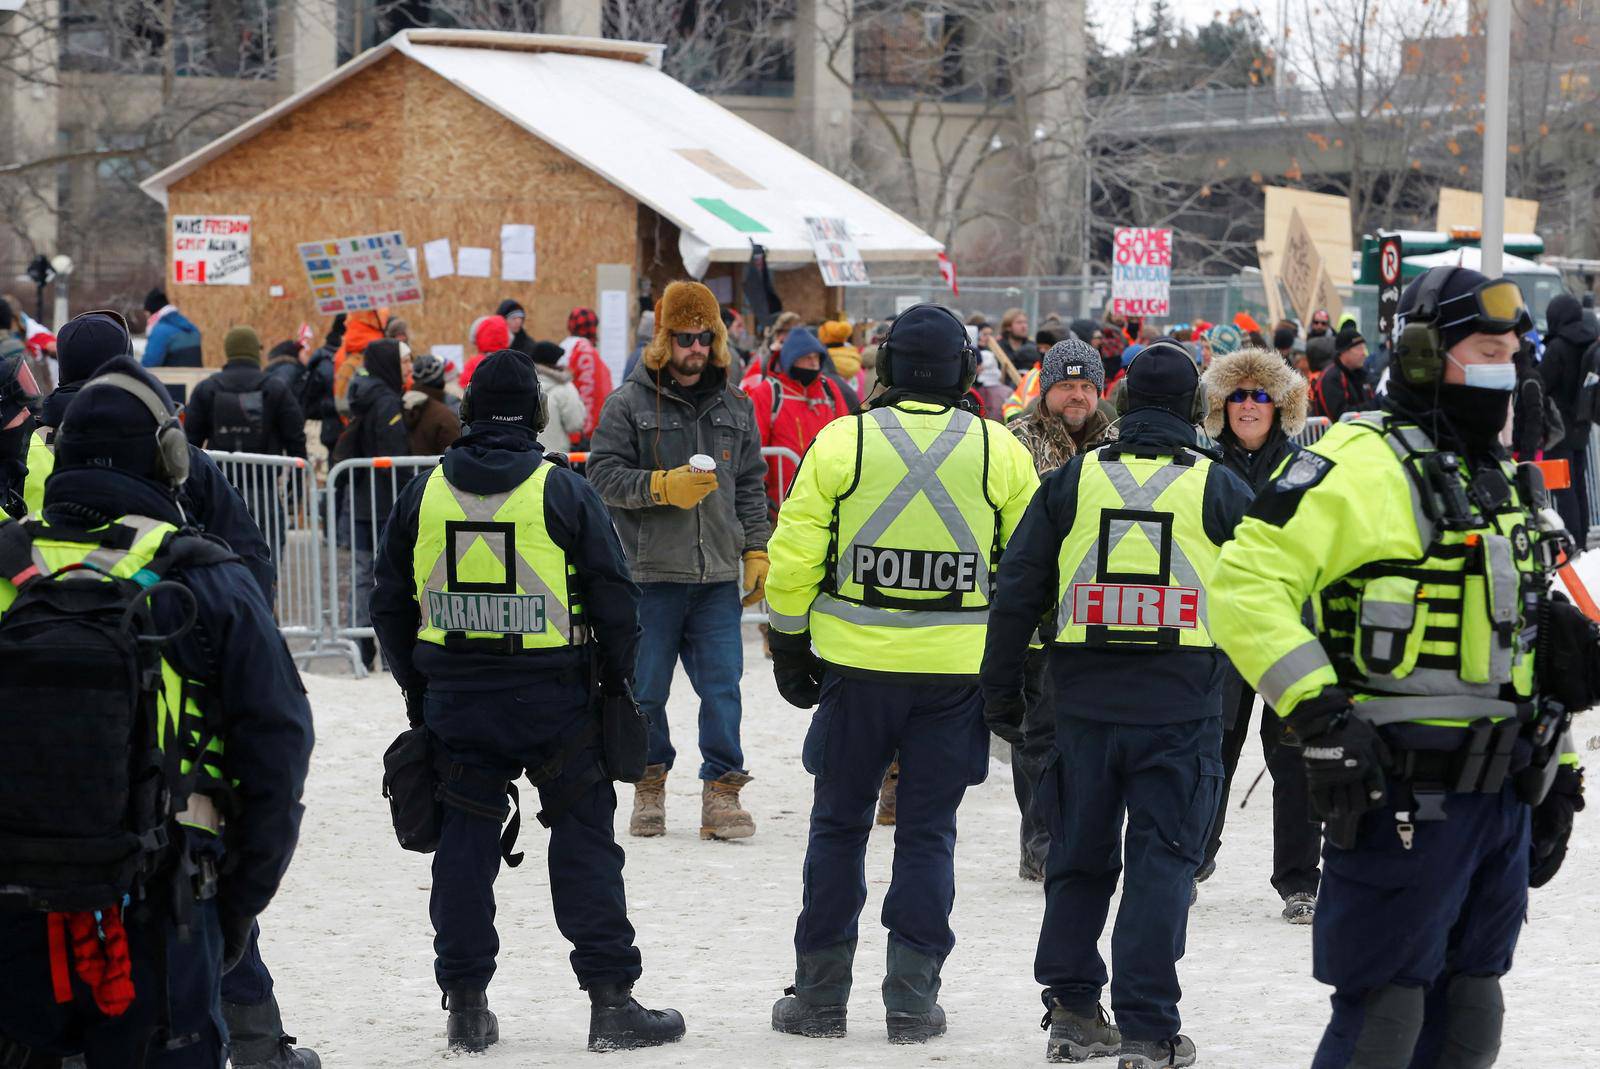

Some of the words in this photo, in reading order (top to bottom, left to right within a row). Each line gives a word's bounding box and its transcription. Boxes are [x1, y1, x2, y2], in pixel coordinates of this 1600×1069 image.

[1115, 228, 1170, 249] GAME
[1115, 248, 1172, 267] OVER
[1113, 298, 1168, 315] ENOUGH
[1066, 365, 1083, 376] CAT
[856, 547, 975, 590] POLICE
[430, 592, 543, 632] PARAMEDIC
[1075, 586, 1197, 627] FIRE
